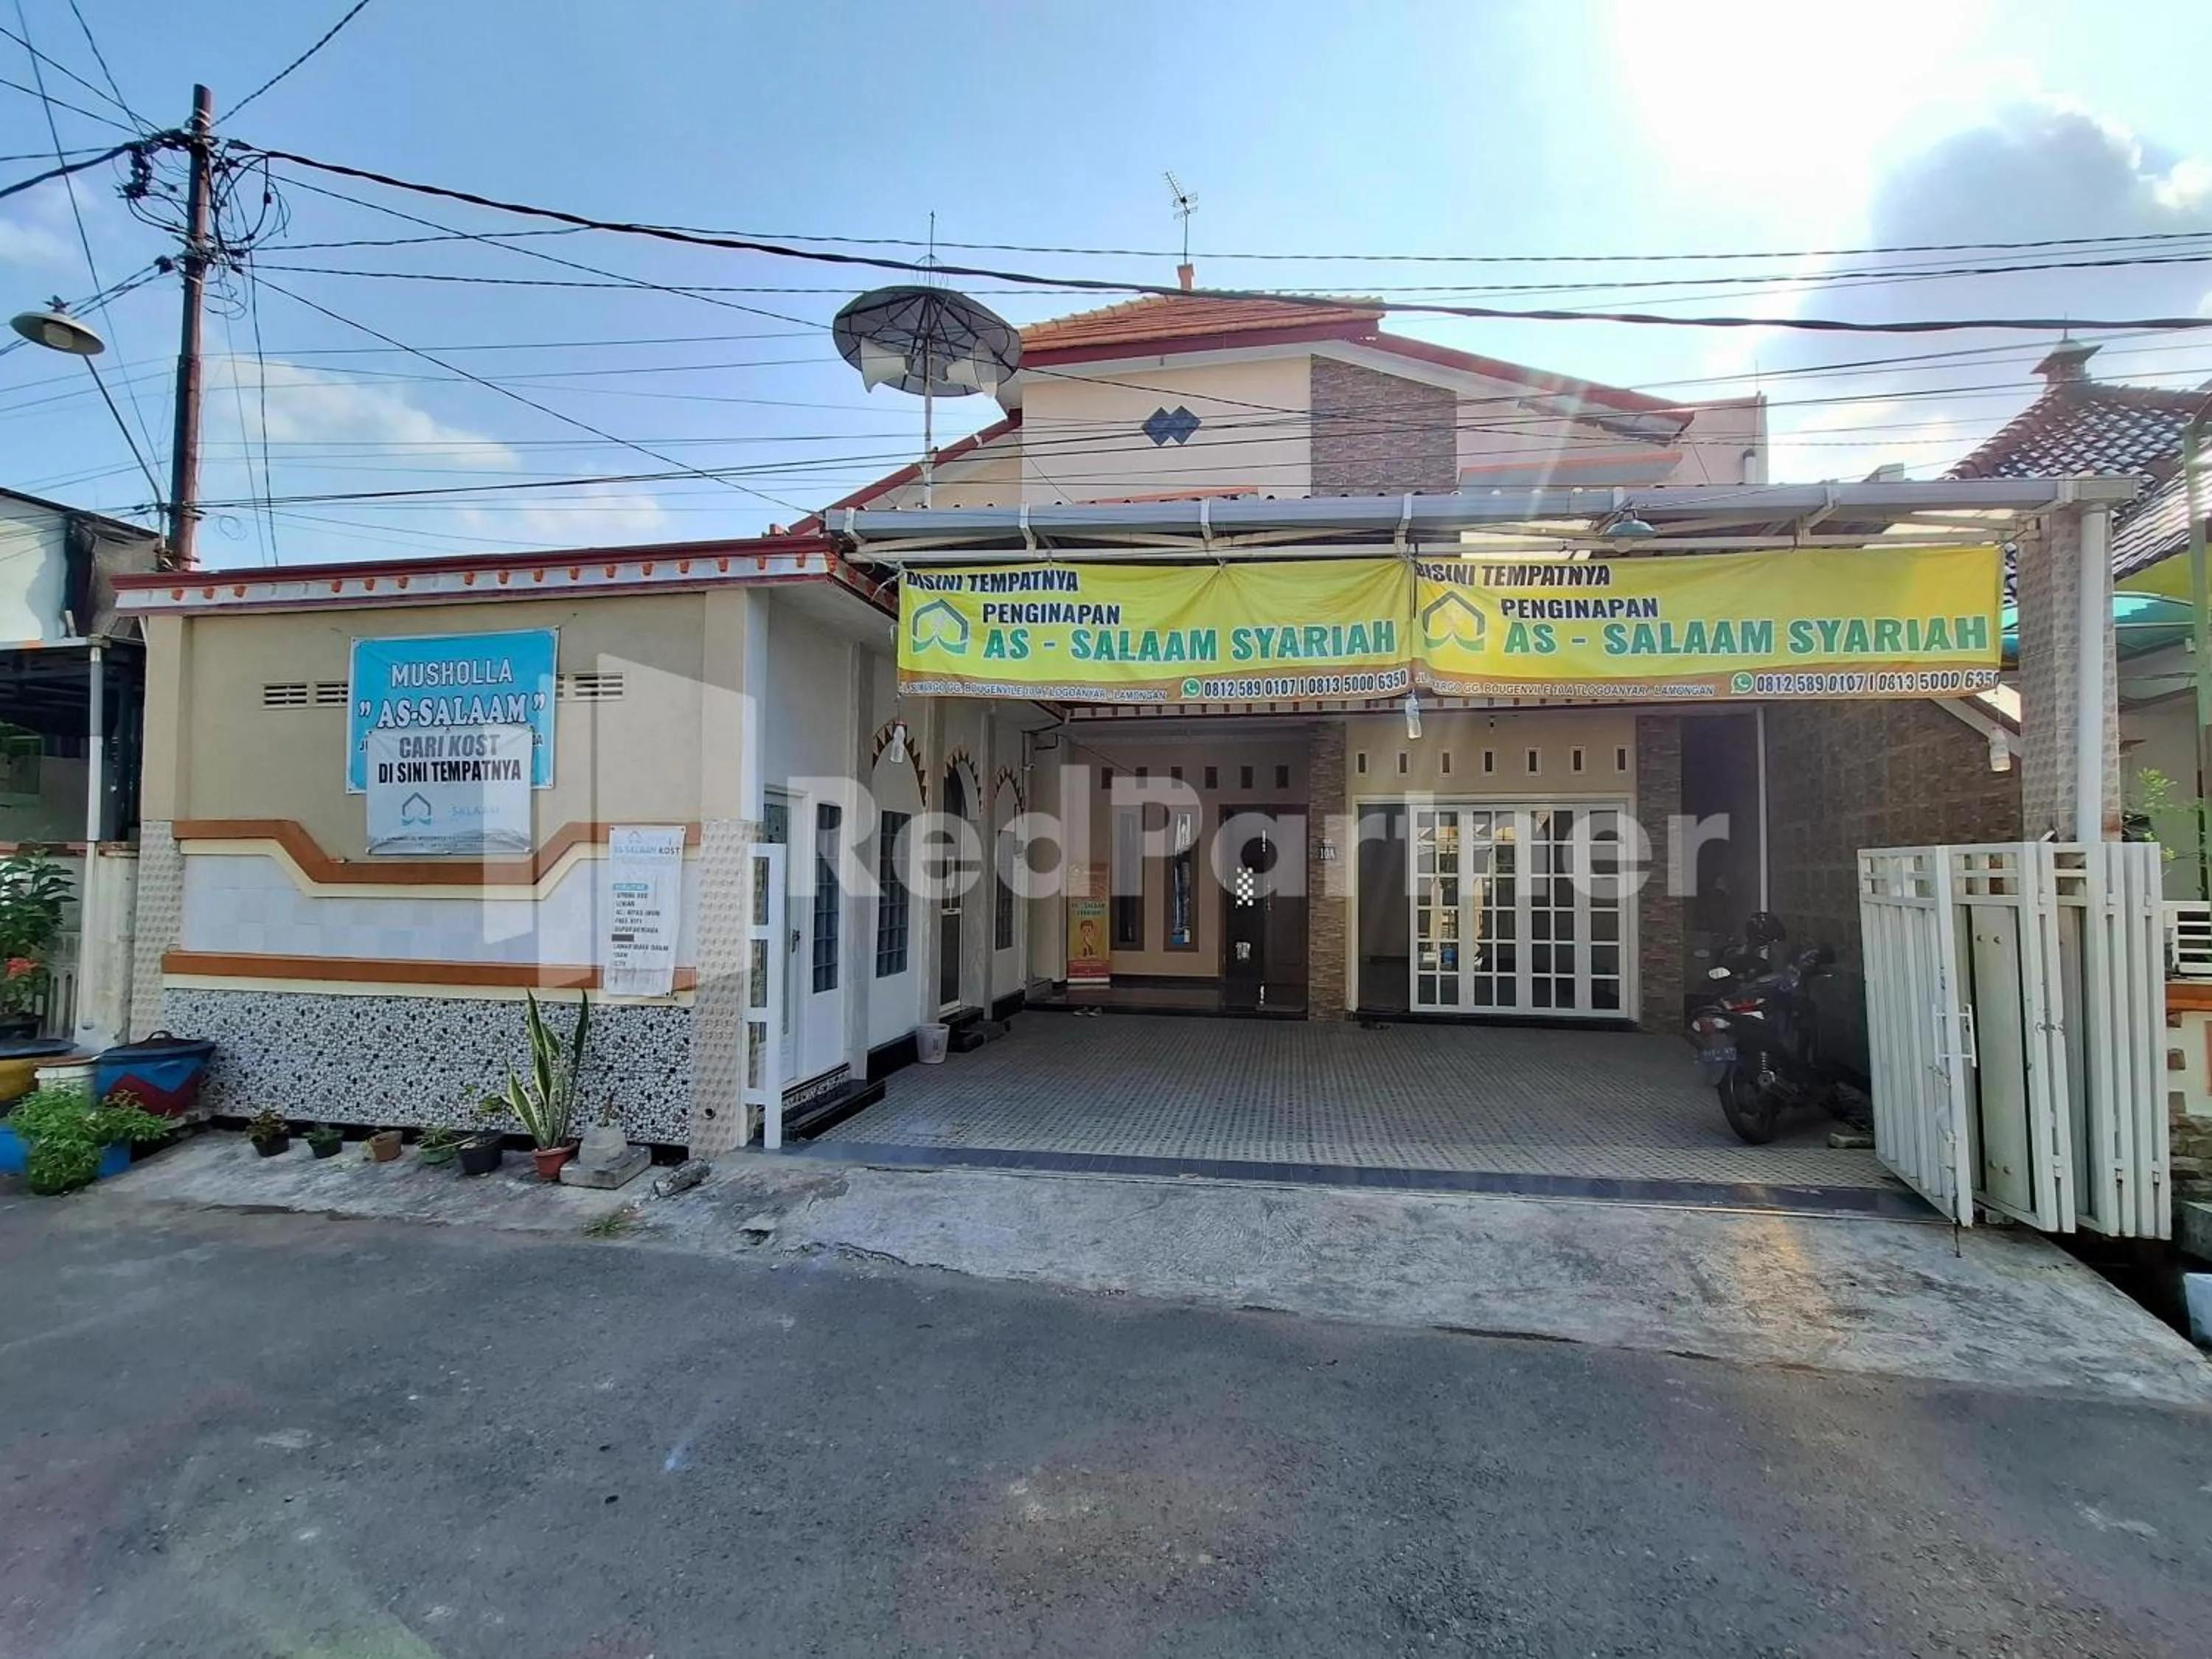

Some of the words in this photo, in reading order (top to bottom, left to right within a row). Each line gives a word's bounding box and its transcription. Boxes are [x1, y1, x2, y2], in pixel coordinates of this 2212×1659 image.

[906, 571, 962, 591] DISINI
[967, 569, 1079, 593] TEMPATNYA
[1481, 565, 1610, 586] TEMPATNYA
[983, 603, 1121, 625] PENGINAPAN
[1501, 598, 1659, 619] PENGINAPAN
[983, 628, 1030, 660] AS
[1071, 628, 1217, 661] SALAAM
[1231, 620, 1396, 661] SYARIAH
[1503, 622, 1557, 653] AS
[1604, 619, 1773, 655] SALAAM
[1787, 616, 1988, 655] SYARIAH
[391, 658, 513, 688] MUSHOLLA
[1203, 681, 1235, 698] 0812
[1239, 681, 1261, 697] 589
[1265, 679, 1296, 695] 0107
[1308, 677, 1340, 694] 0813
[1344, 675, 1374, 692] 5000
[1378, 670, 1408, 689] 6350
[1756, 675, 1792, 693] 0812
[1797, 674, 1825, 692] 589
[1827, 674, 1864, 692] 0107
[1879, 673, 1915, 691] 0813
[1919, 672, 1959, 690] 5000
[1965, 670, 2000, 689] 6350
[1653, 684, 1715, 697] LAMONGAN
[399, 737, 443, 759] CARI
[446, 734, 501, 758] KOST
[378, 762, 393, 784] DI
[398, 761, 428, 783] SINI
[431, 759, 521, 783] TEMPATNYA
